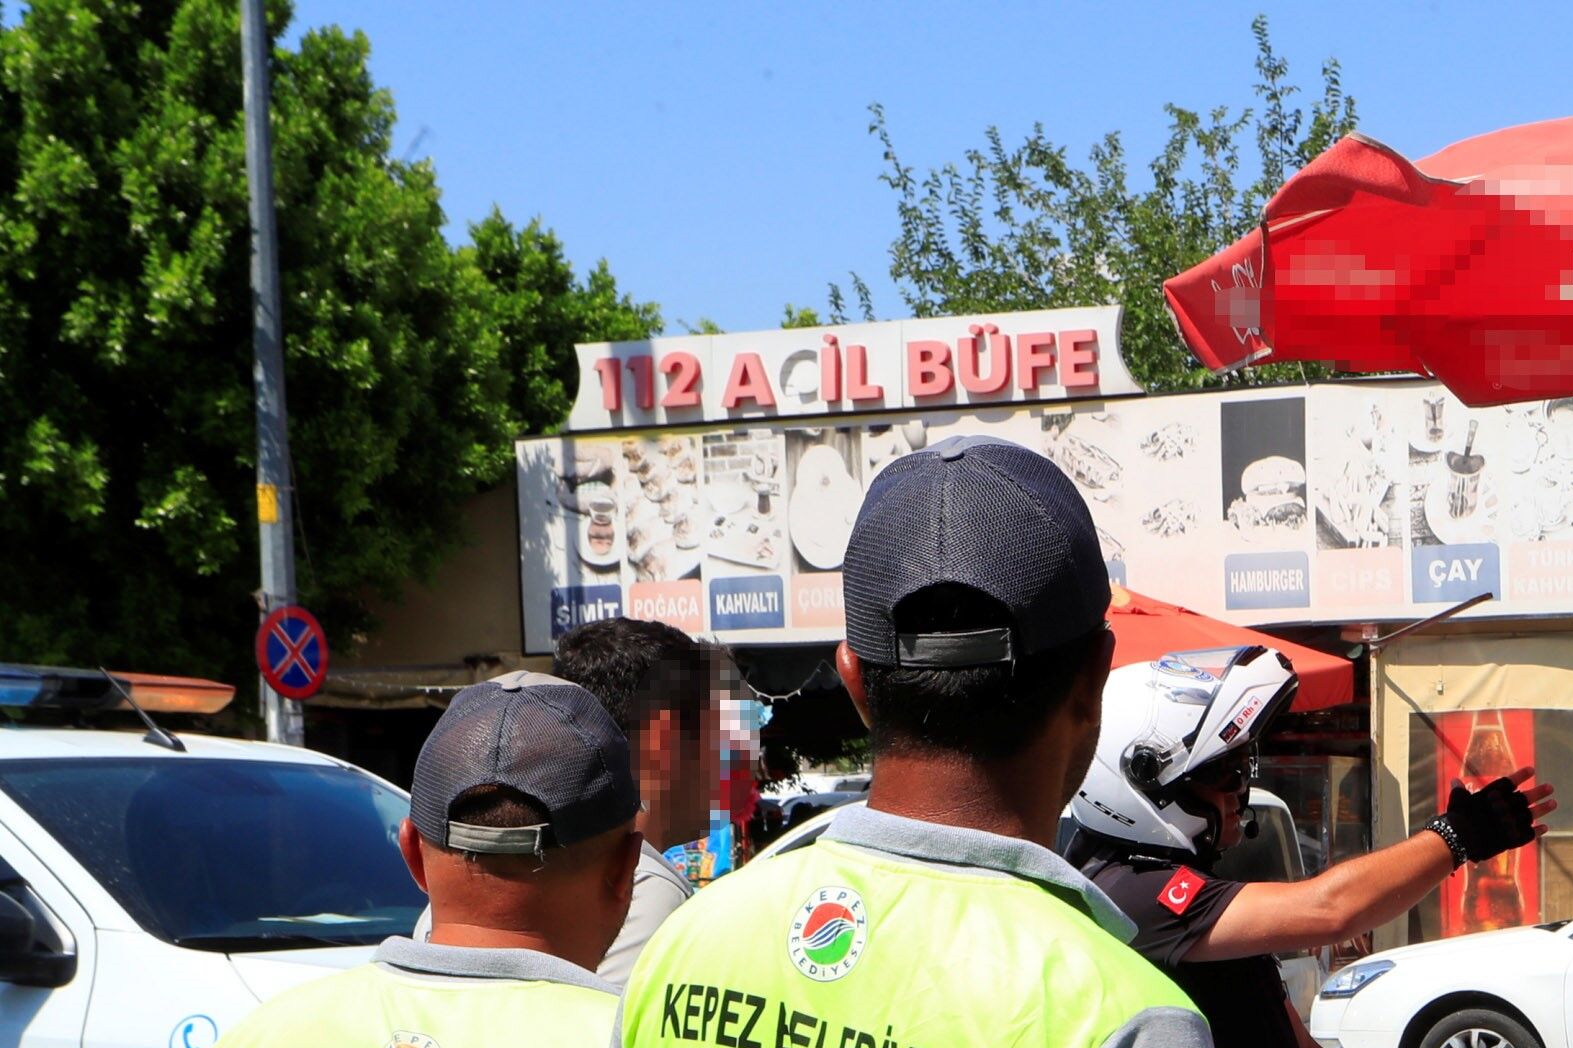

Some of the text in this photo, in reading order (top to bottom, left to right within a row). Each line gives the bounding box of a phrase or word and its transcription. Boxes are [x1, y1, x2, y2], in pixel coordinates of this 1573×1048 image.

[593, 350, 703, 412] 112
[906, 323, 1099, 398] BÜFE
[1230, 568, 1304, 594] HAMBURGER
[1428, 558, 1484, 589] ÇAY
[556, 598, 619, 626] SİMİT
[633, 594, 700, 621] POĞAÇA
[715, 591, 779, 616] KAHVALTI
[804, 890, 866, 929] KEPEZ
